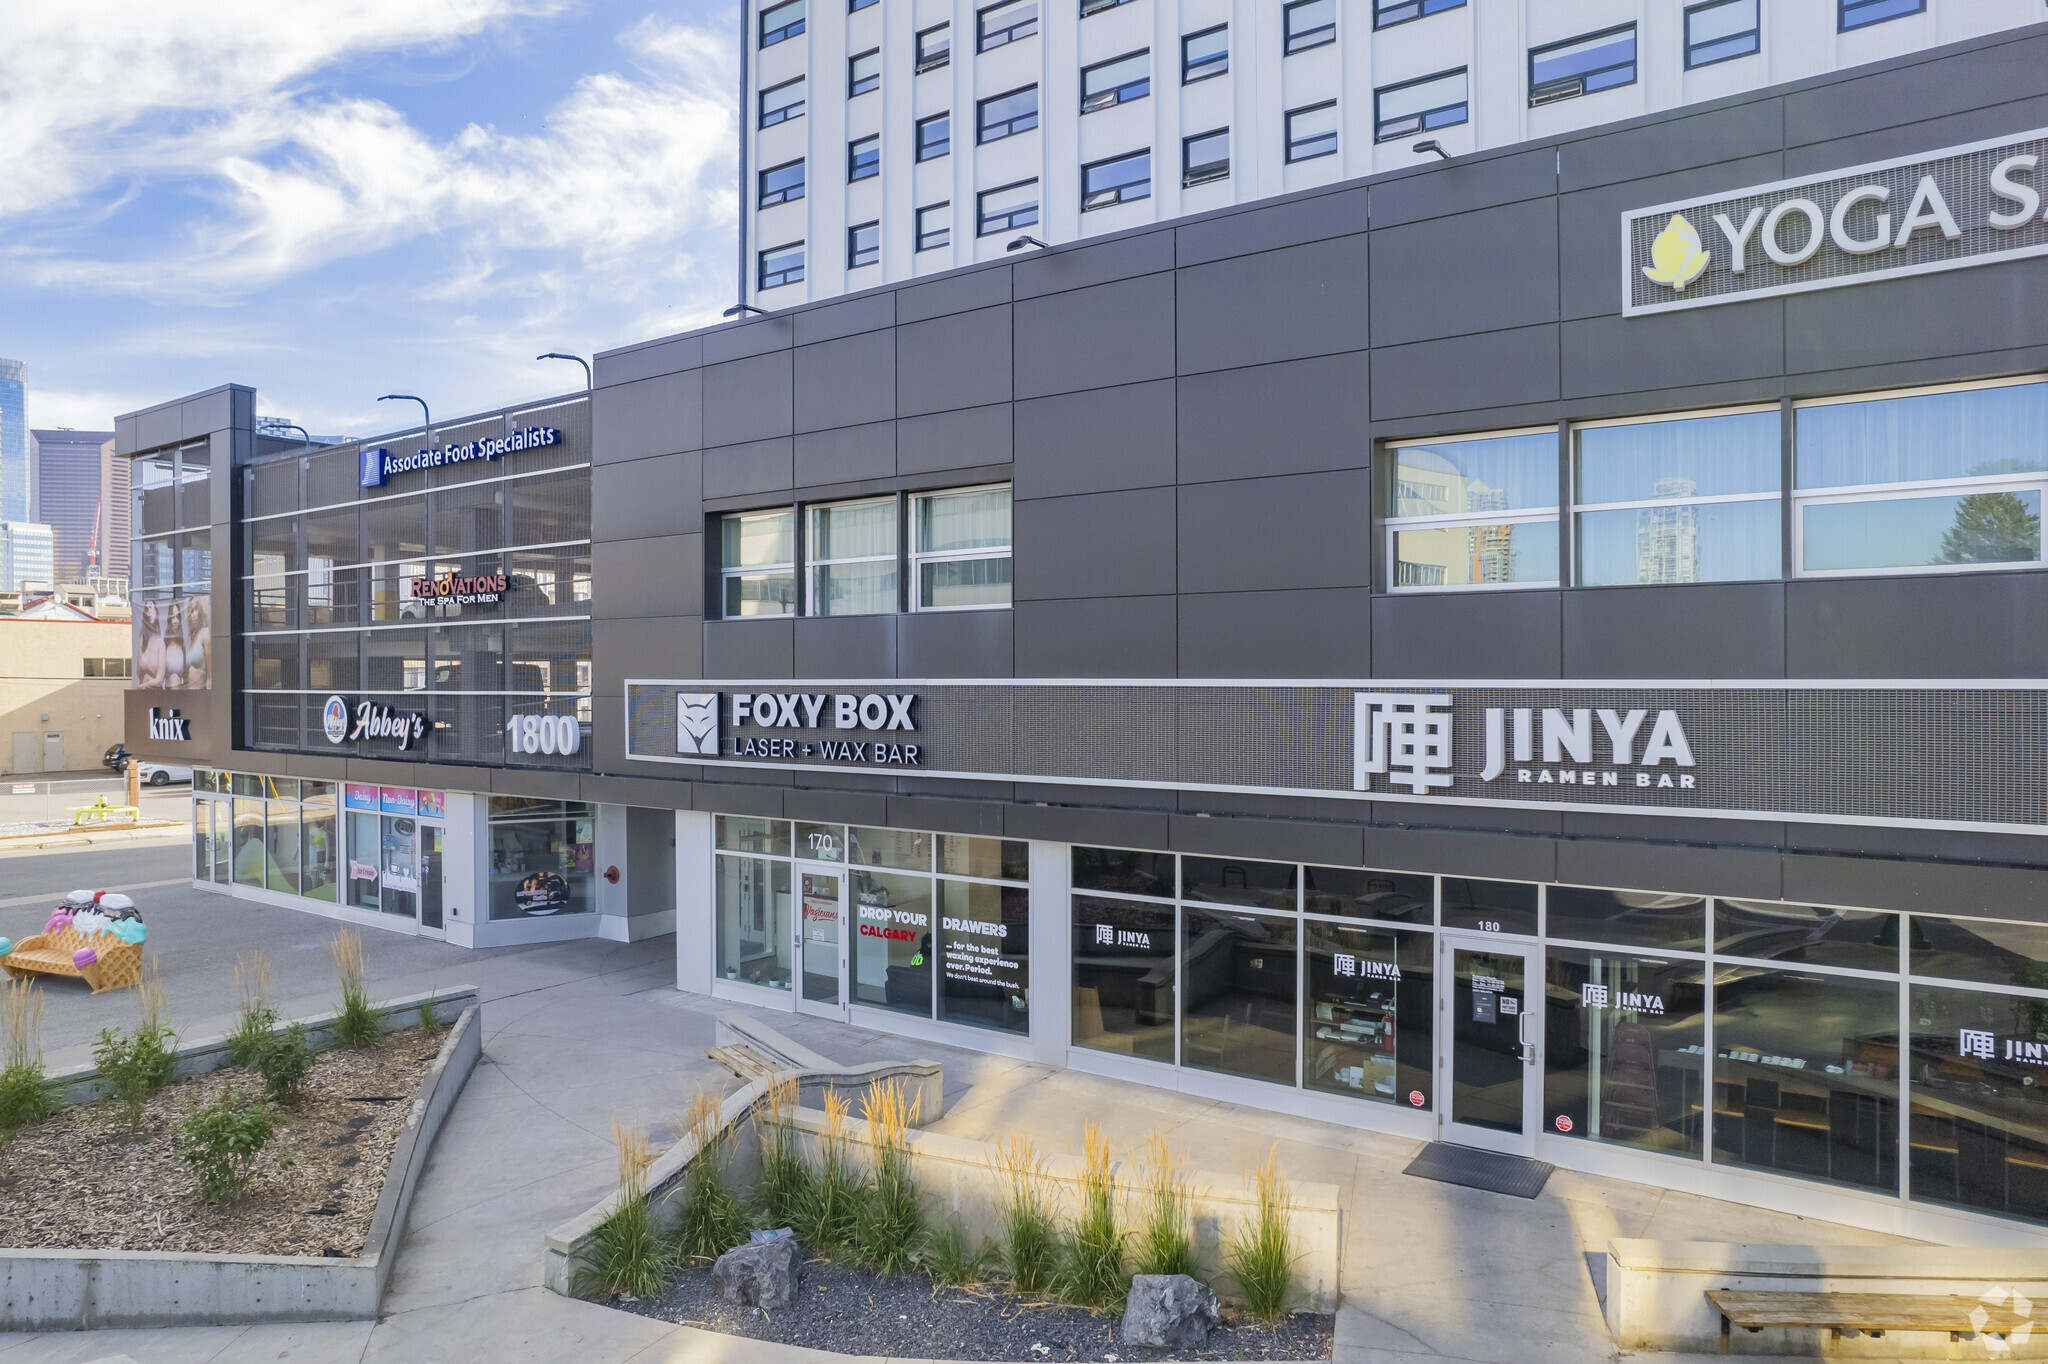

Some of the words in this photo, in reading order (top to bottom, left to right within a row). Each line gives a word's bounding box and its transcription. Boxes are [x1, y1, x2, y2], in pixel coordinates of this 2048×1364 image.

[1712, 174, 1962, 275] YOGA
[1989, 154, 2048, 231] S
[383, 449, 442, 475] Associate
[445, 443, 475, 464] Foot
[478, 427, 555, 461] Specialists
[477, 593, 499, 603] MEN
[732, 693, 826, 728] FOXY
[835, 694, 915, 730] BOX
[149, 707, 185, 741] knix
[349, 701, 424, 751] Abbey's
[506, 714, 580, 756] 1800
[1479, 707, 1696, 781] JINYA
[734, 737, 795, 758] LASER
[820, 741, 866, 762] WAX
[874, 744, 918, 765] BAR
[1518, 769, 1619, 786] RAMEN
[1635, 773, 1696, 789] BAR
[808, 833, 833, 851] 170
[859, 906, 892, 921] DROP
[893, 910, 927, 927] YOUR
[1478, 920, 1500, 932] 180
[860, 924, 917, 943] CALGARY
[943, 917, 1007, 938] DRAWERS
[1117, 930, 1150, 945] JINYA
[953, 941, 965, 950] for
[966, 943, 980, 953] the
[980, 945, 999, 956] best
[945, 951, 974, 963] waxing
[974, 956, 1019, 969] experience
[945, 962, 965, 971] ever.
[965, 963, 993, 976] Period.
[1360, 960, 1401, 977] JINYA
[954, 973, 967, 981] don't
[979, 978, 997, 986] around
[997, 979, 1006, 987] the
[1006, 981, 1020, 990] bush.
[1615, 991, 1665, 1010] JINYA
